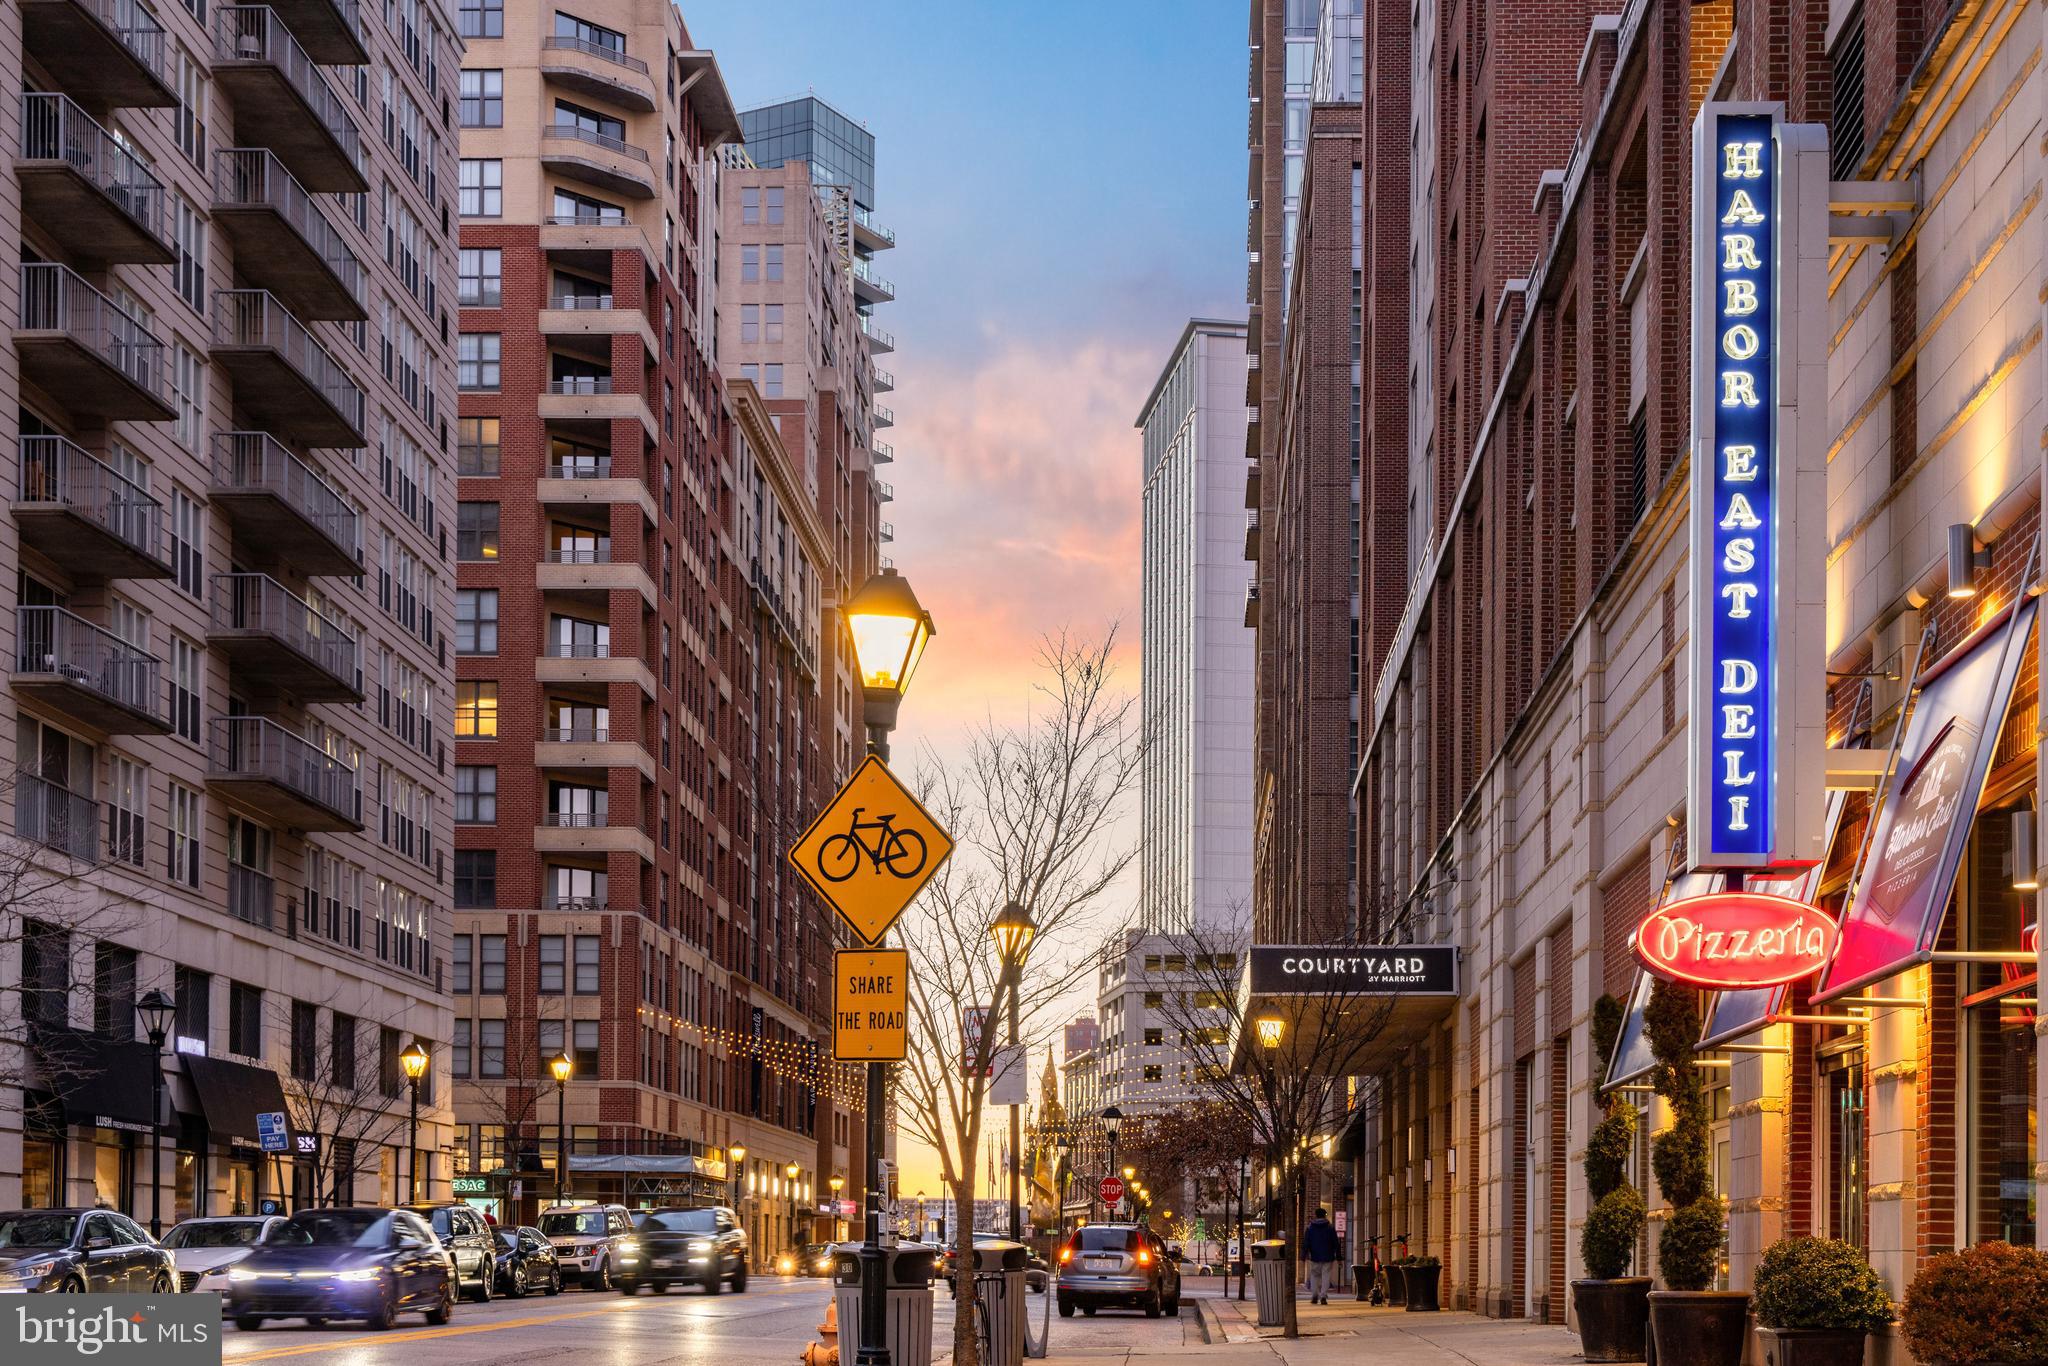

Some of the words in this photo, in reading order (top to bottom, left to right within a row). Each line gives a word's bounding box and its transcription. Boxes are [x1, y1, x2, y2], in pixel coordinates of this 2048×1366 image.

[1721, 142, 1766, 408] HARBOR
[1720, 445, 1762, 619] EAST
[1719, 659, 1758, 832] DELI
[1886, 871, 1919, 895] PIZZERIA
[1658, 915, 1825, 962] Pizzeria
[1282, 957, 1425, 975] COURTYARD
[849, 975, 893, 994] SHARE
[1381, 975, 1426, 983] MARRIOTT
[838, 1011, 861, 1030] THE
[869, 1011, 904, 1030] ROAD
[95, 1114, 113, 1128] LUSH
[1100, 1184, 1122, 1194] STOP
